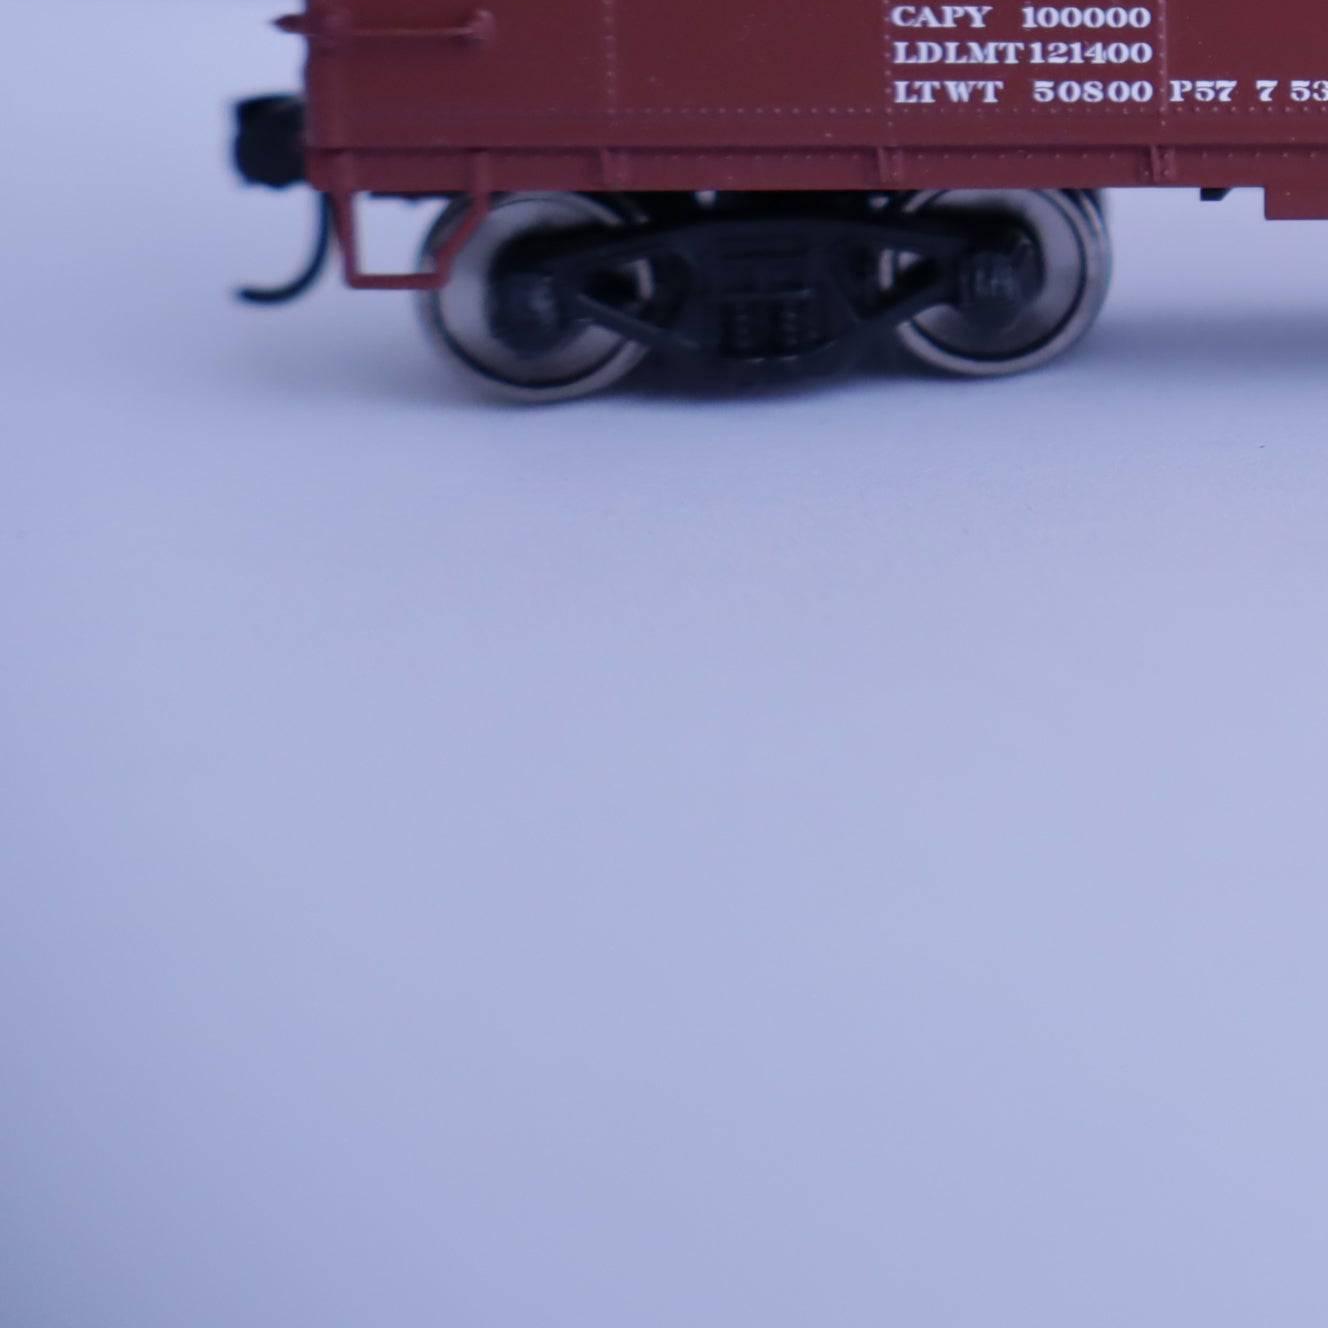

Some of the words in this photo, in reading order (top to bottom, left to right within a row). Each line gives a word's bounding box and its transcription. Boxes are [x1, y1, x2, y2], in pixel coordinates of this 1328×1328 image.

[890, 4, 994, 29] CAPY
[1021, 5, 1152, 29] 100000
[893, 40, 1025, 65] LDLMT
[1028, 40, 1153, 65] 121400
[1032, 79, 1153, 104] 50800
[1168, 78, 1238, 103] P57
[1254, 78, 1279, 103] 7
